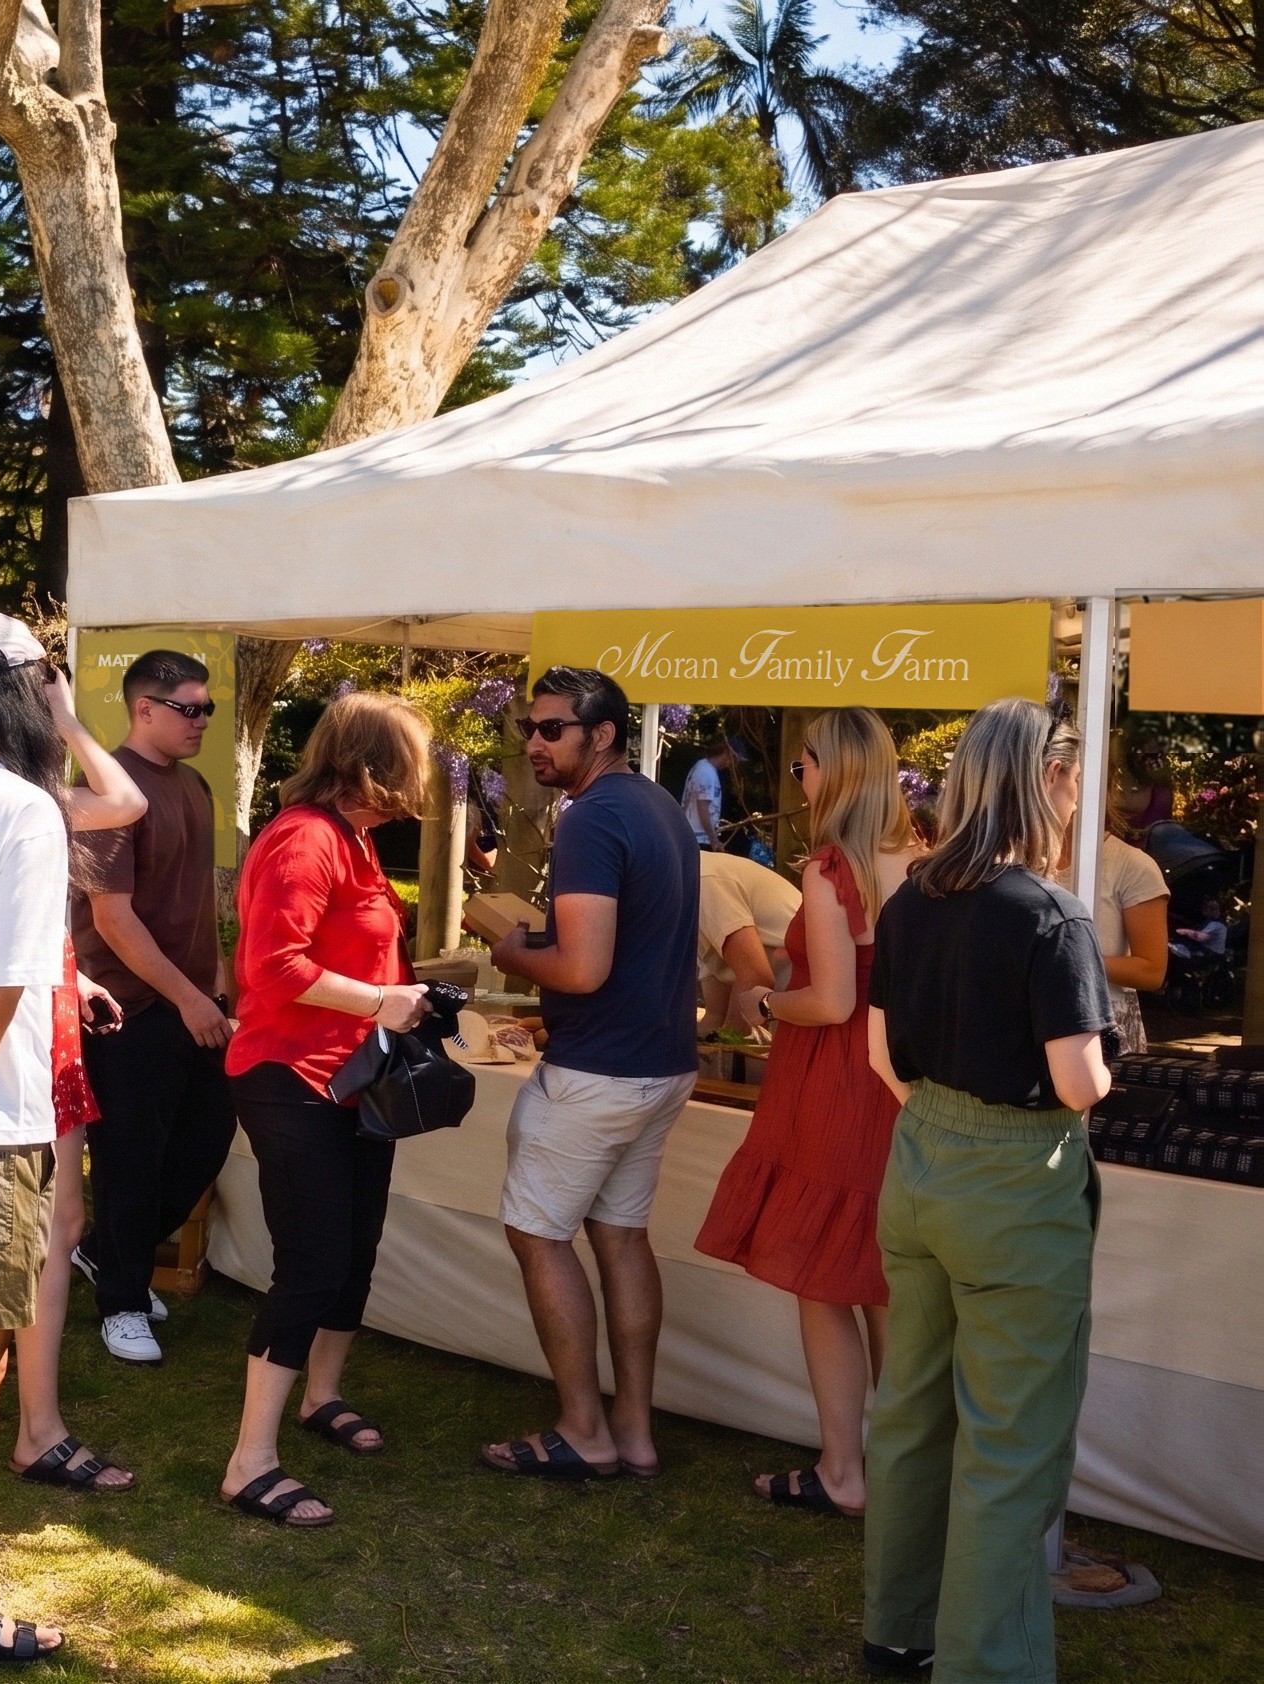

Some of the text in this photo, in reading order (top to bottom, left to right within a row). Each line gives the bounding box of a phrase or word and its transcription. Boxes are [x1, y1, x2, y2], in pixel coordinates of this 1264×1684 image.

[597, 629, 970, 687] Moran Family Farm
